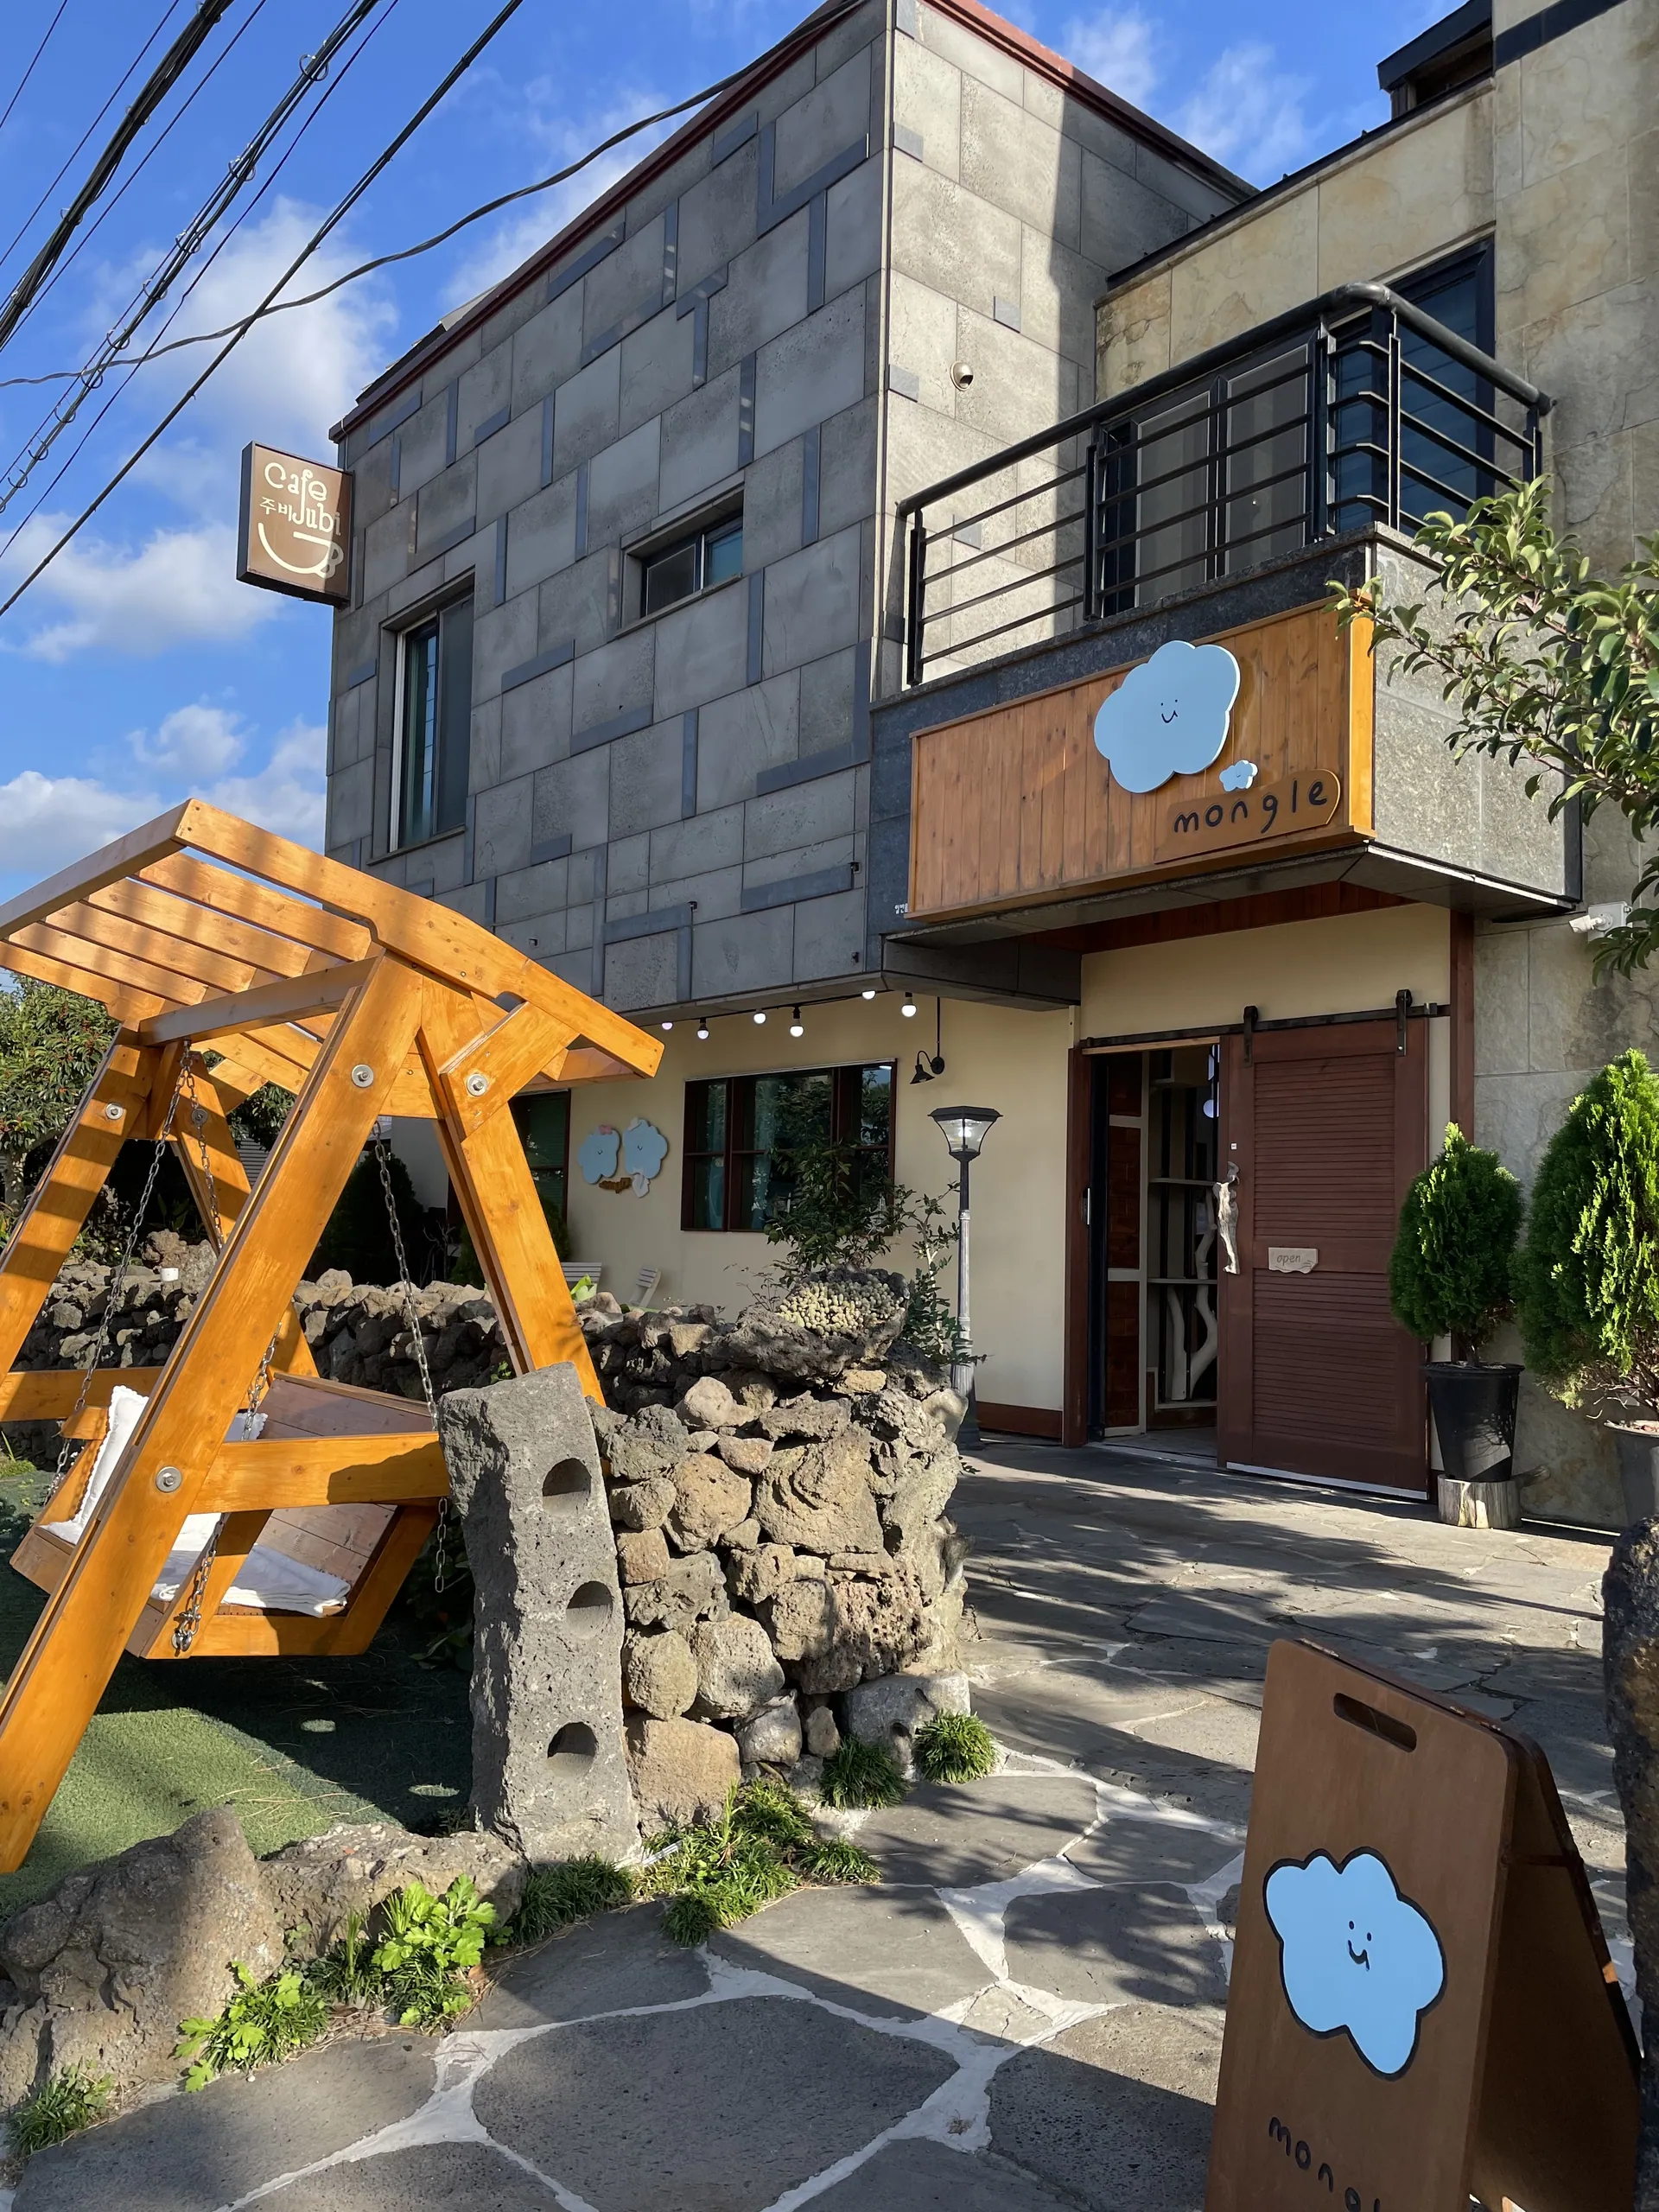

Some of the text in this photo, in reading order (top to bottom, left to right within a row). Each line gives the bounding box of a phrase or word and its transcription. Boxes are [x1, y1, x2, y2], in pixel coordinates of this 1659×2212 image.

[259, 496, 292, 522] 주비
[1173, 779, 1327, 834] mongle
[1276, 1255, 1301, 1266] open
